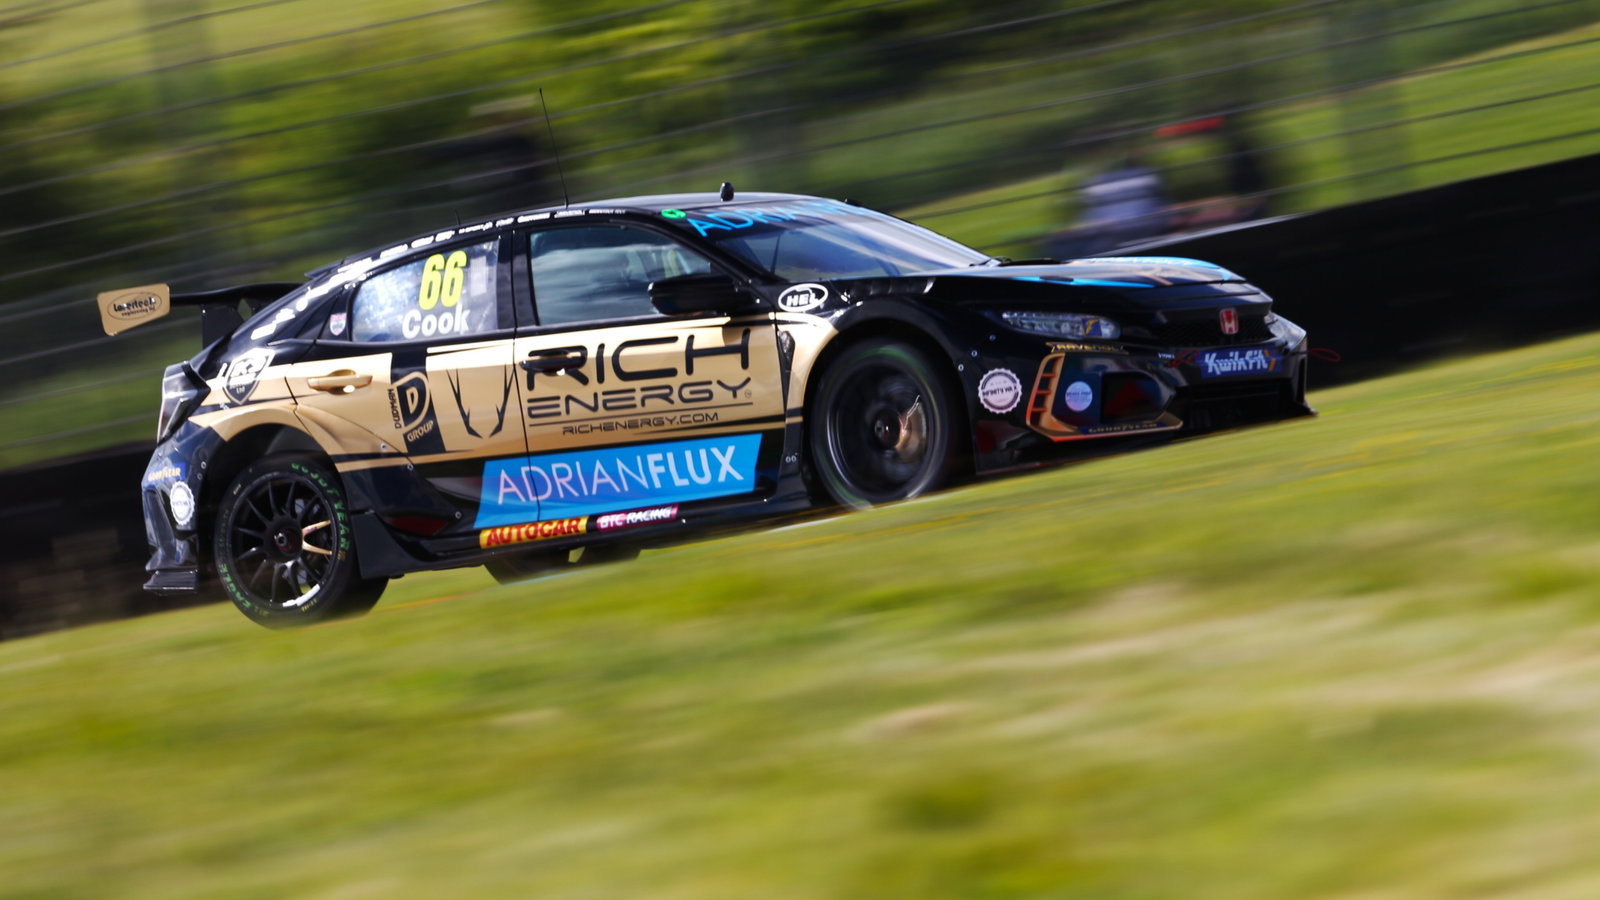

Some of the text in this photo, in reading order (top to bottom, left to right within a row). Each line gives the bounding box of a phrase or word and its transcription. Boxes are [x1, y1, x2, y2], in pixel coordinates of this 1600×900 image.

[418, 250, 468, 310] 66
[402, 303, 470, 339] Cook
[521, 327, 751, 391] RICH
[527, 376, 751, 419] ENERGY
[407, 420, 434, 442] GROUP
[562, 412, 719, 436] RICHENERGY.COM
[627, 506, 673, 524] RACING
[486, 520, 581, 547] AUTOCAR
